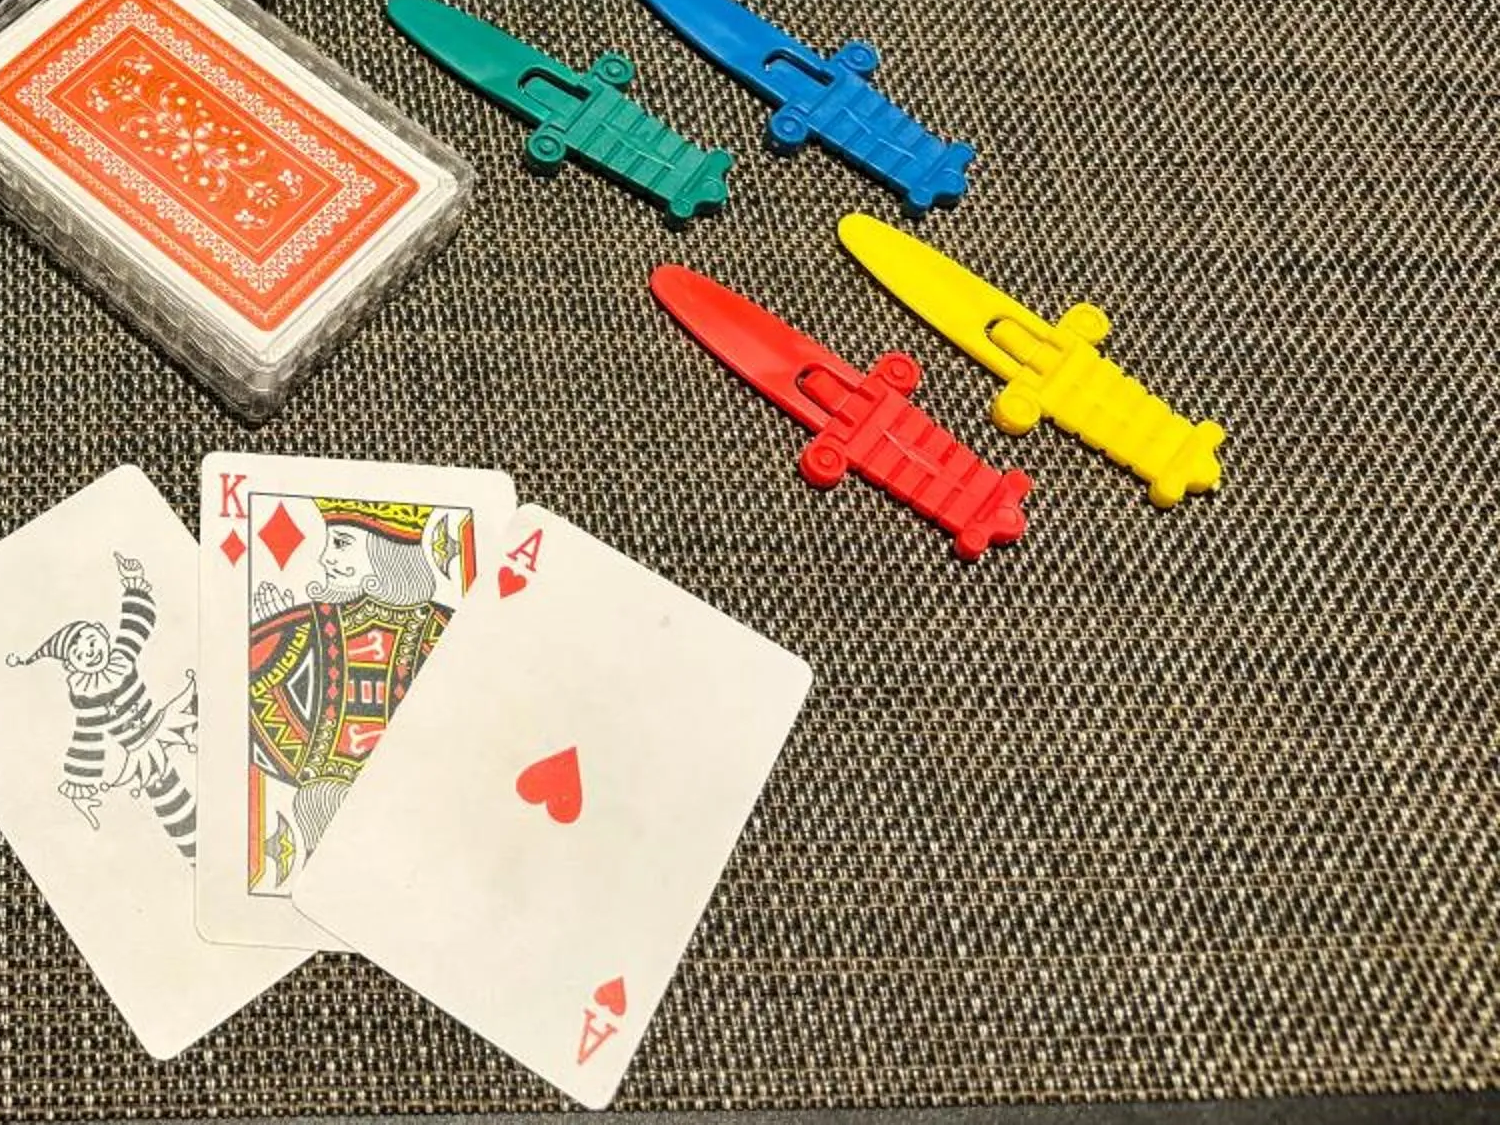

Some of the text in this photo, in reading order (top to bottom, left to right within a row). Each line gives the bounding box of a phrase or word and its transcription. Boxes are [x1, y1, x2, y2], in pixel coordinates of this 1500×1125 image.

[219, 472, 248, 519] K
[505, 528, 543, 572] A
[577, 1007, 619, 1065] A
